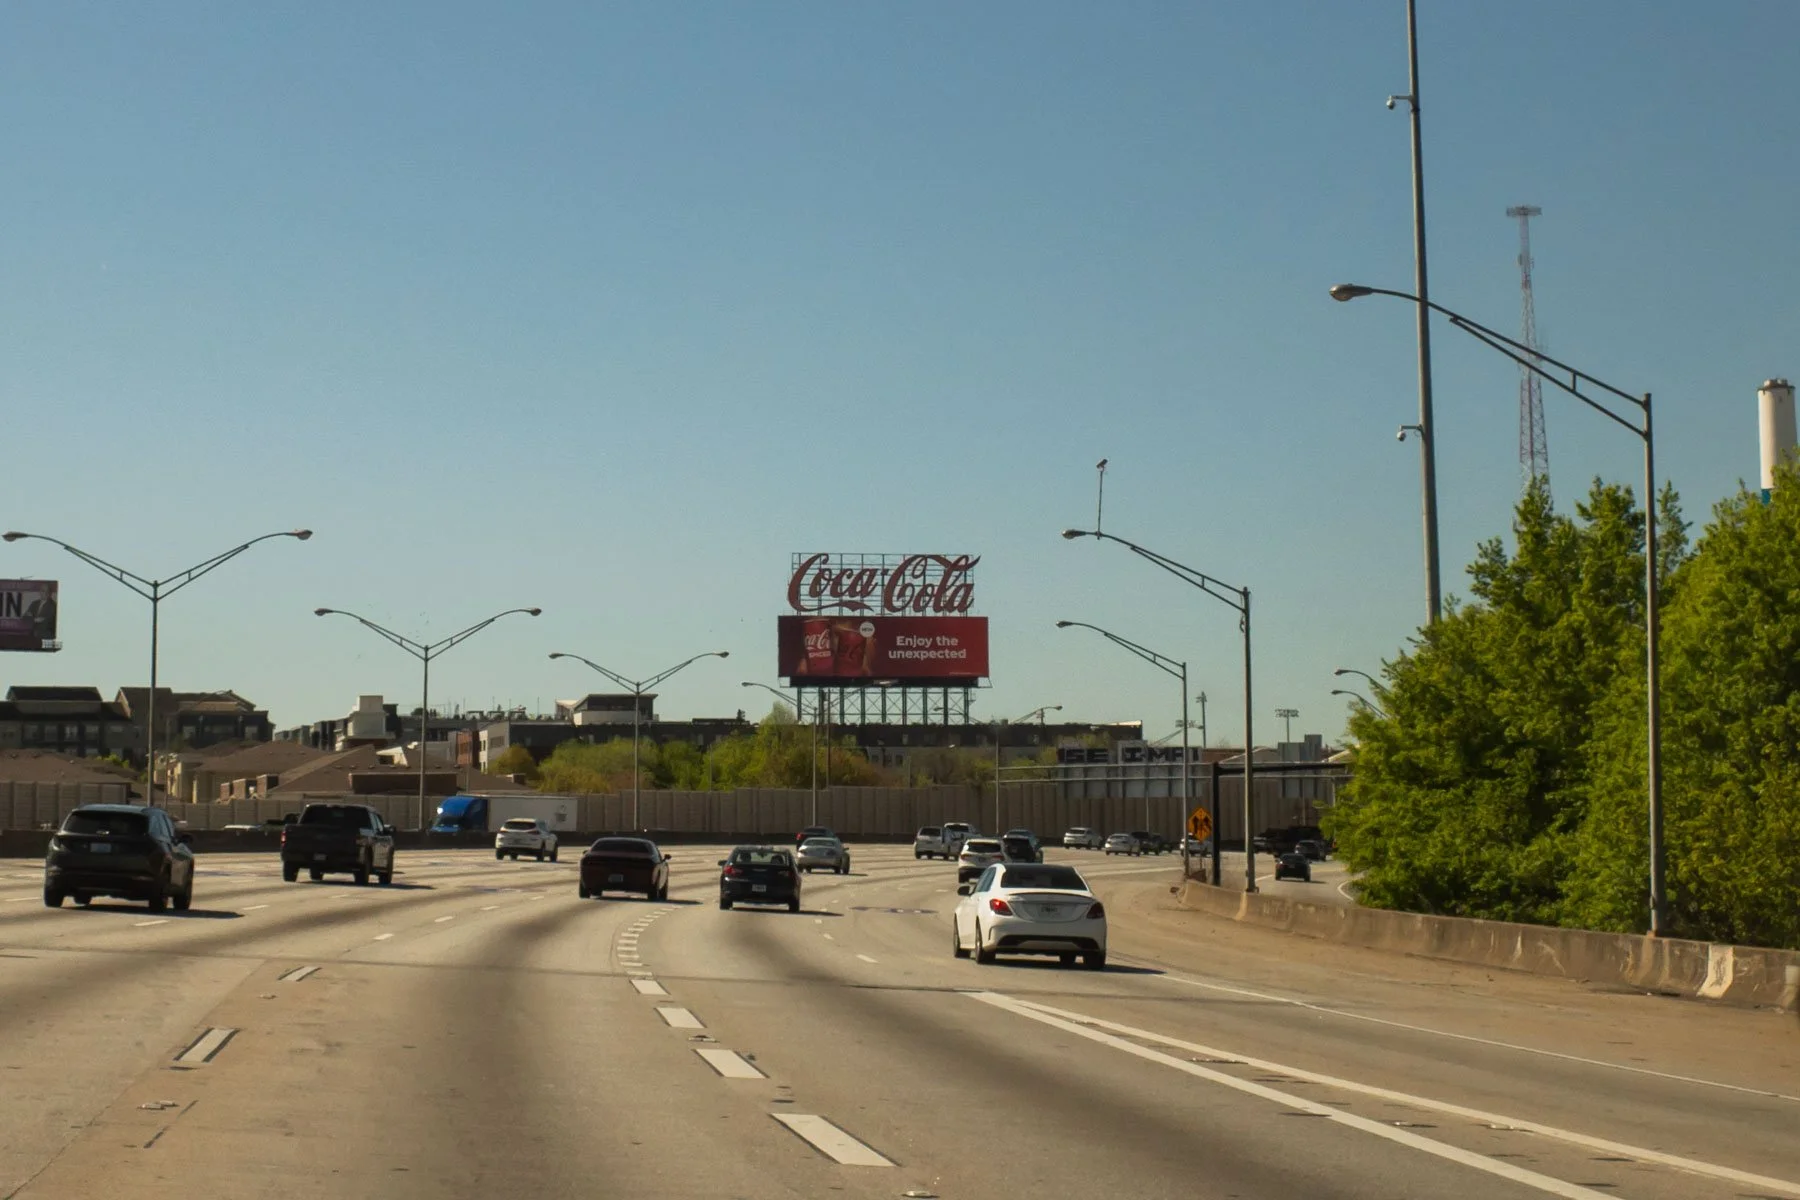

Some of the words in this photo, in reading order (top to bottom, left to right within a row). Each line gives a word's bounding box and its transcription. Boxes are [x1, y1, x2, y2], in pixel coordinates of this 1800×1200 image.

[787, 553, 981, 613] Coca-Cola
[896, 635, 933, 648] Enjoy
[936, 635, 959, 646] the
[888, 649, 967, 661] unexpected
